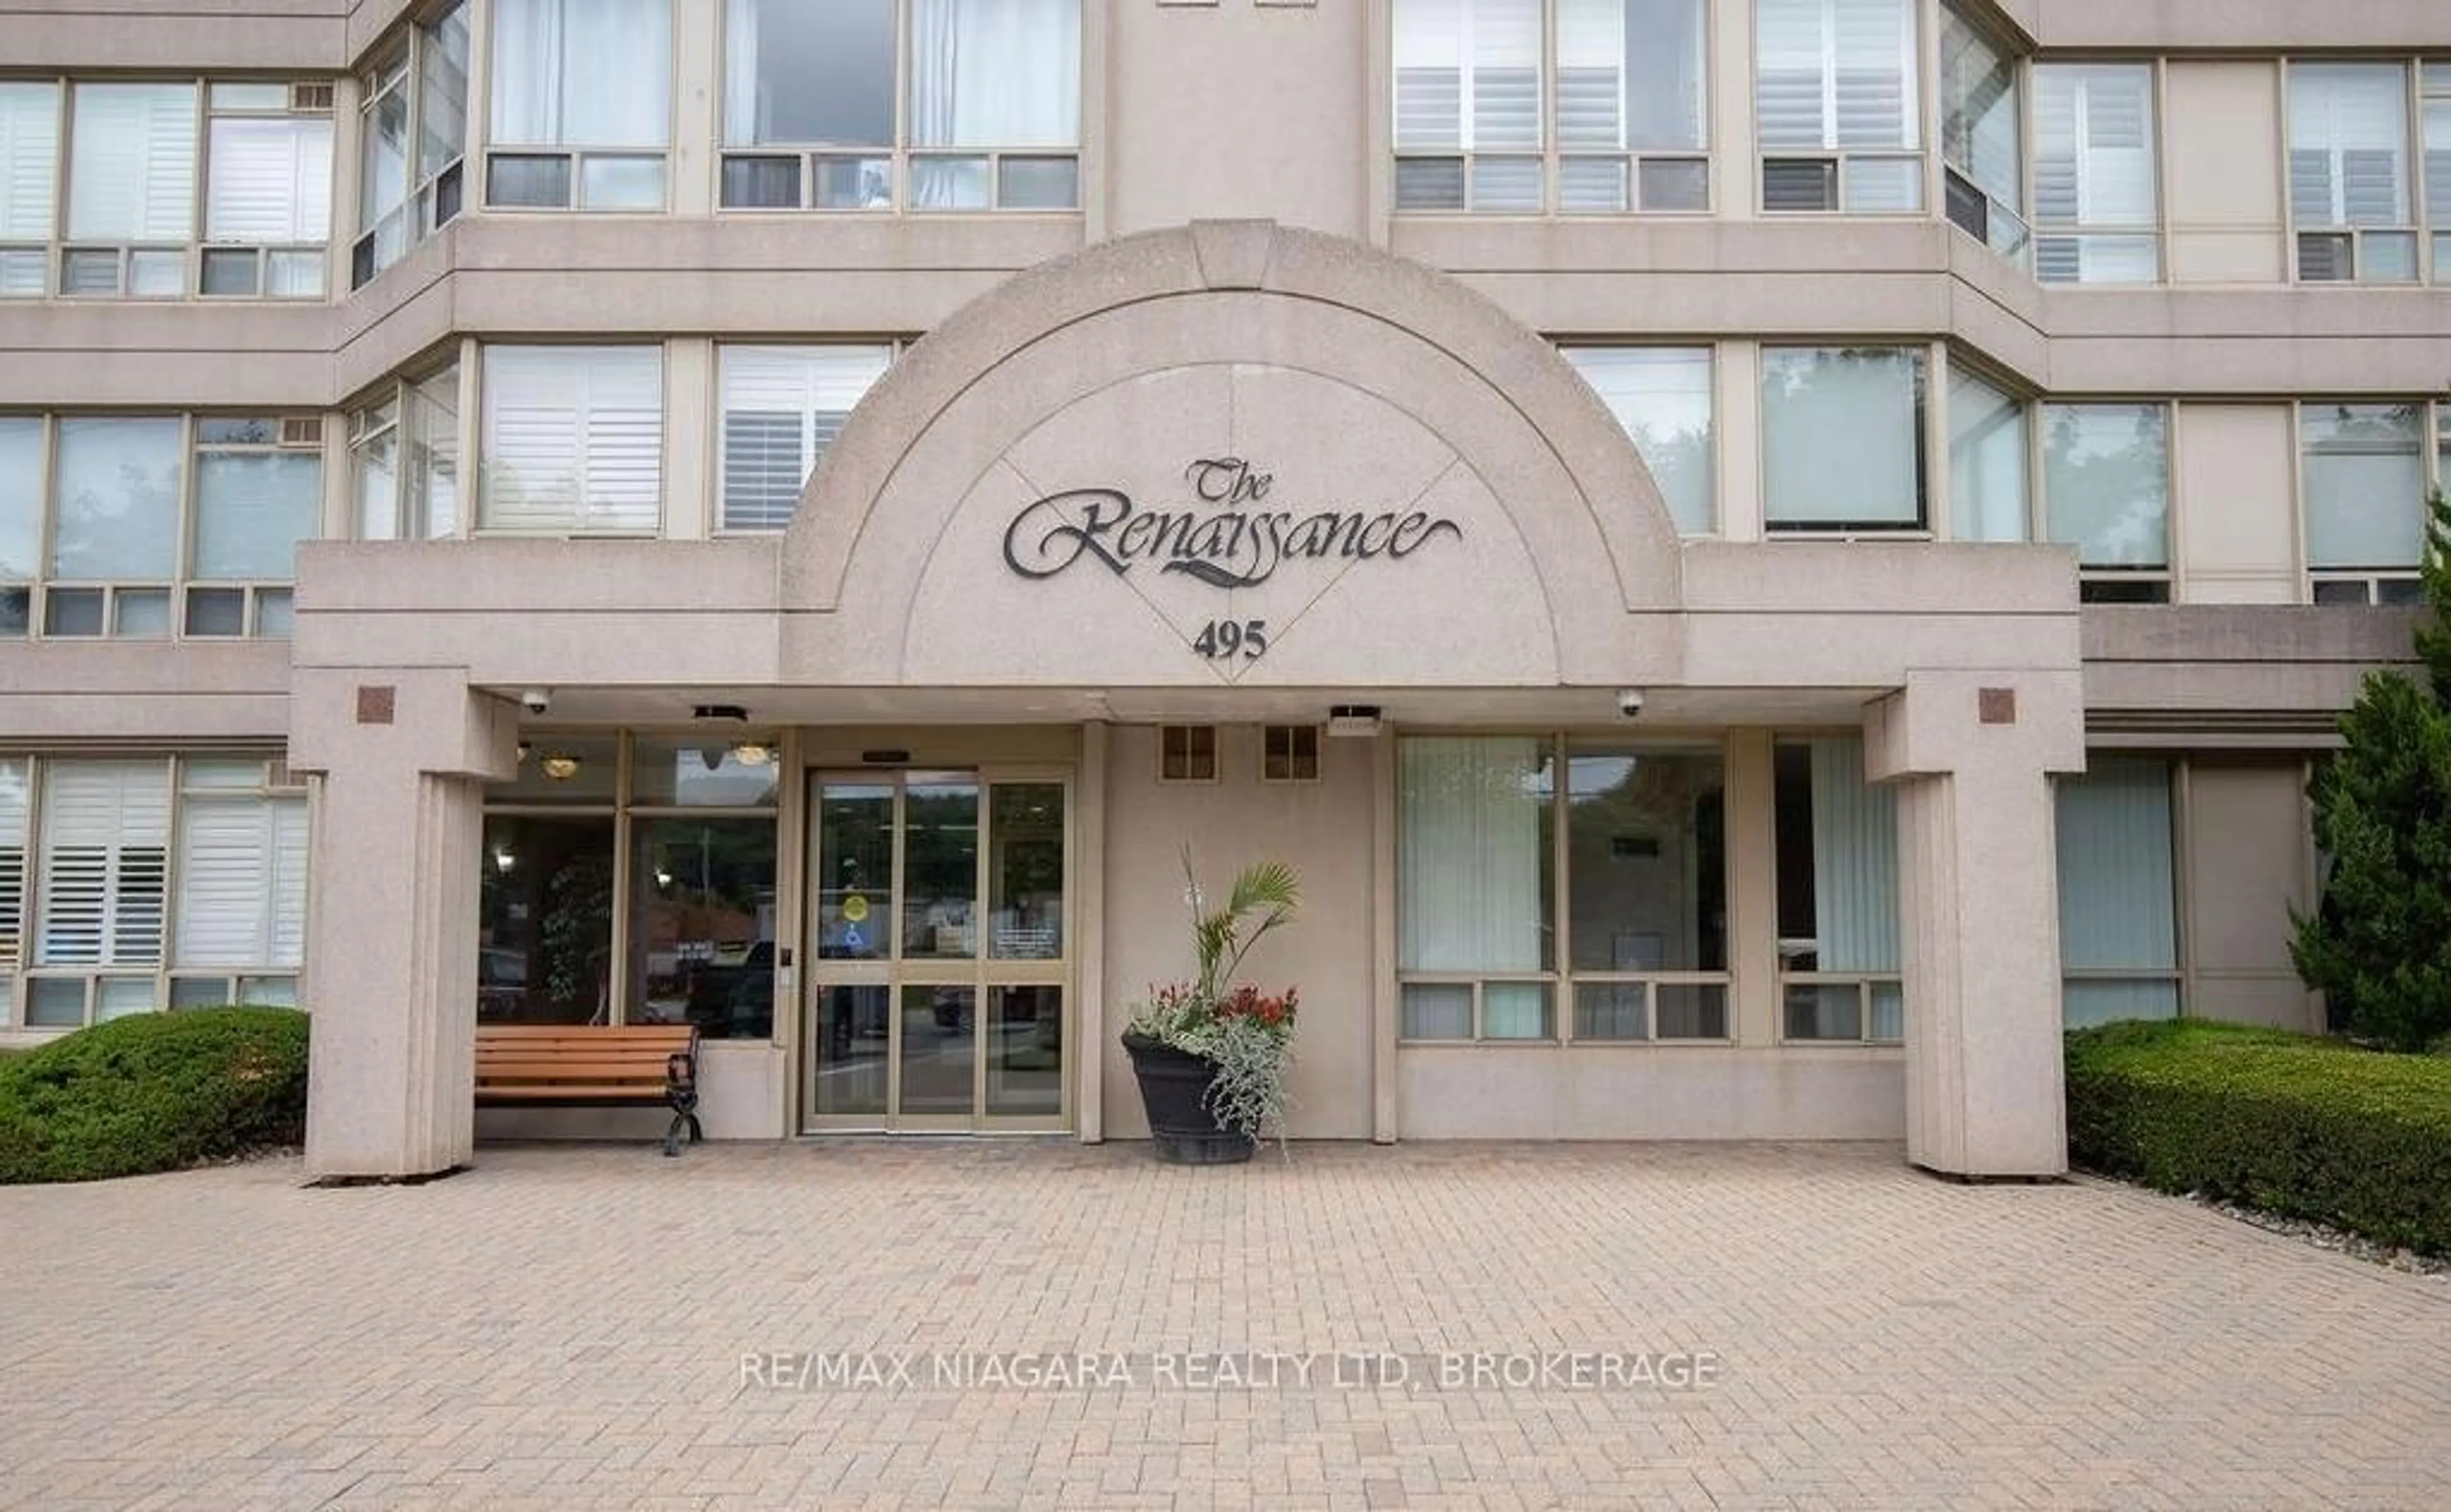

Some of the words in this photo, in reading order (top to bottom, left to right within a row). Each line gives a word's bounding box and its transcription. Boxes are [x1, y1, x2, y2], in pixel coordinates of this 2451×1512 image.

[1185, 457, 1273, 502] The
[1003, 488, 1463, 588] Renaissance
[1193, 620, 1267, 658] 495
